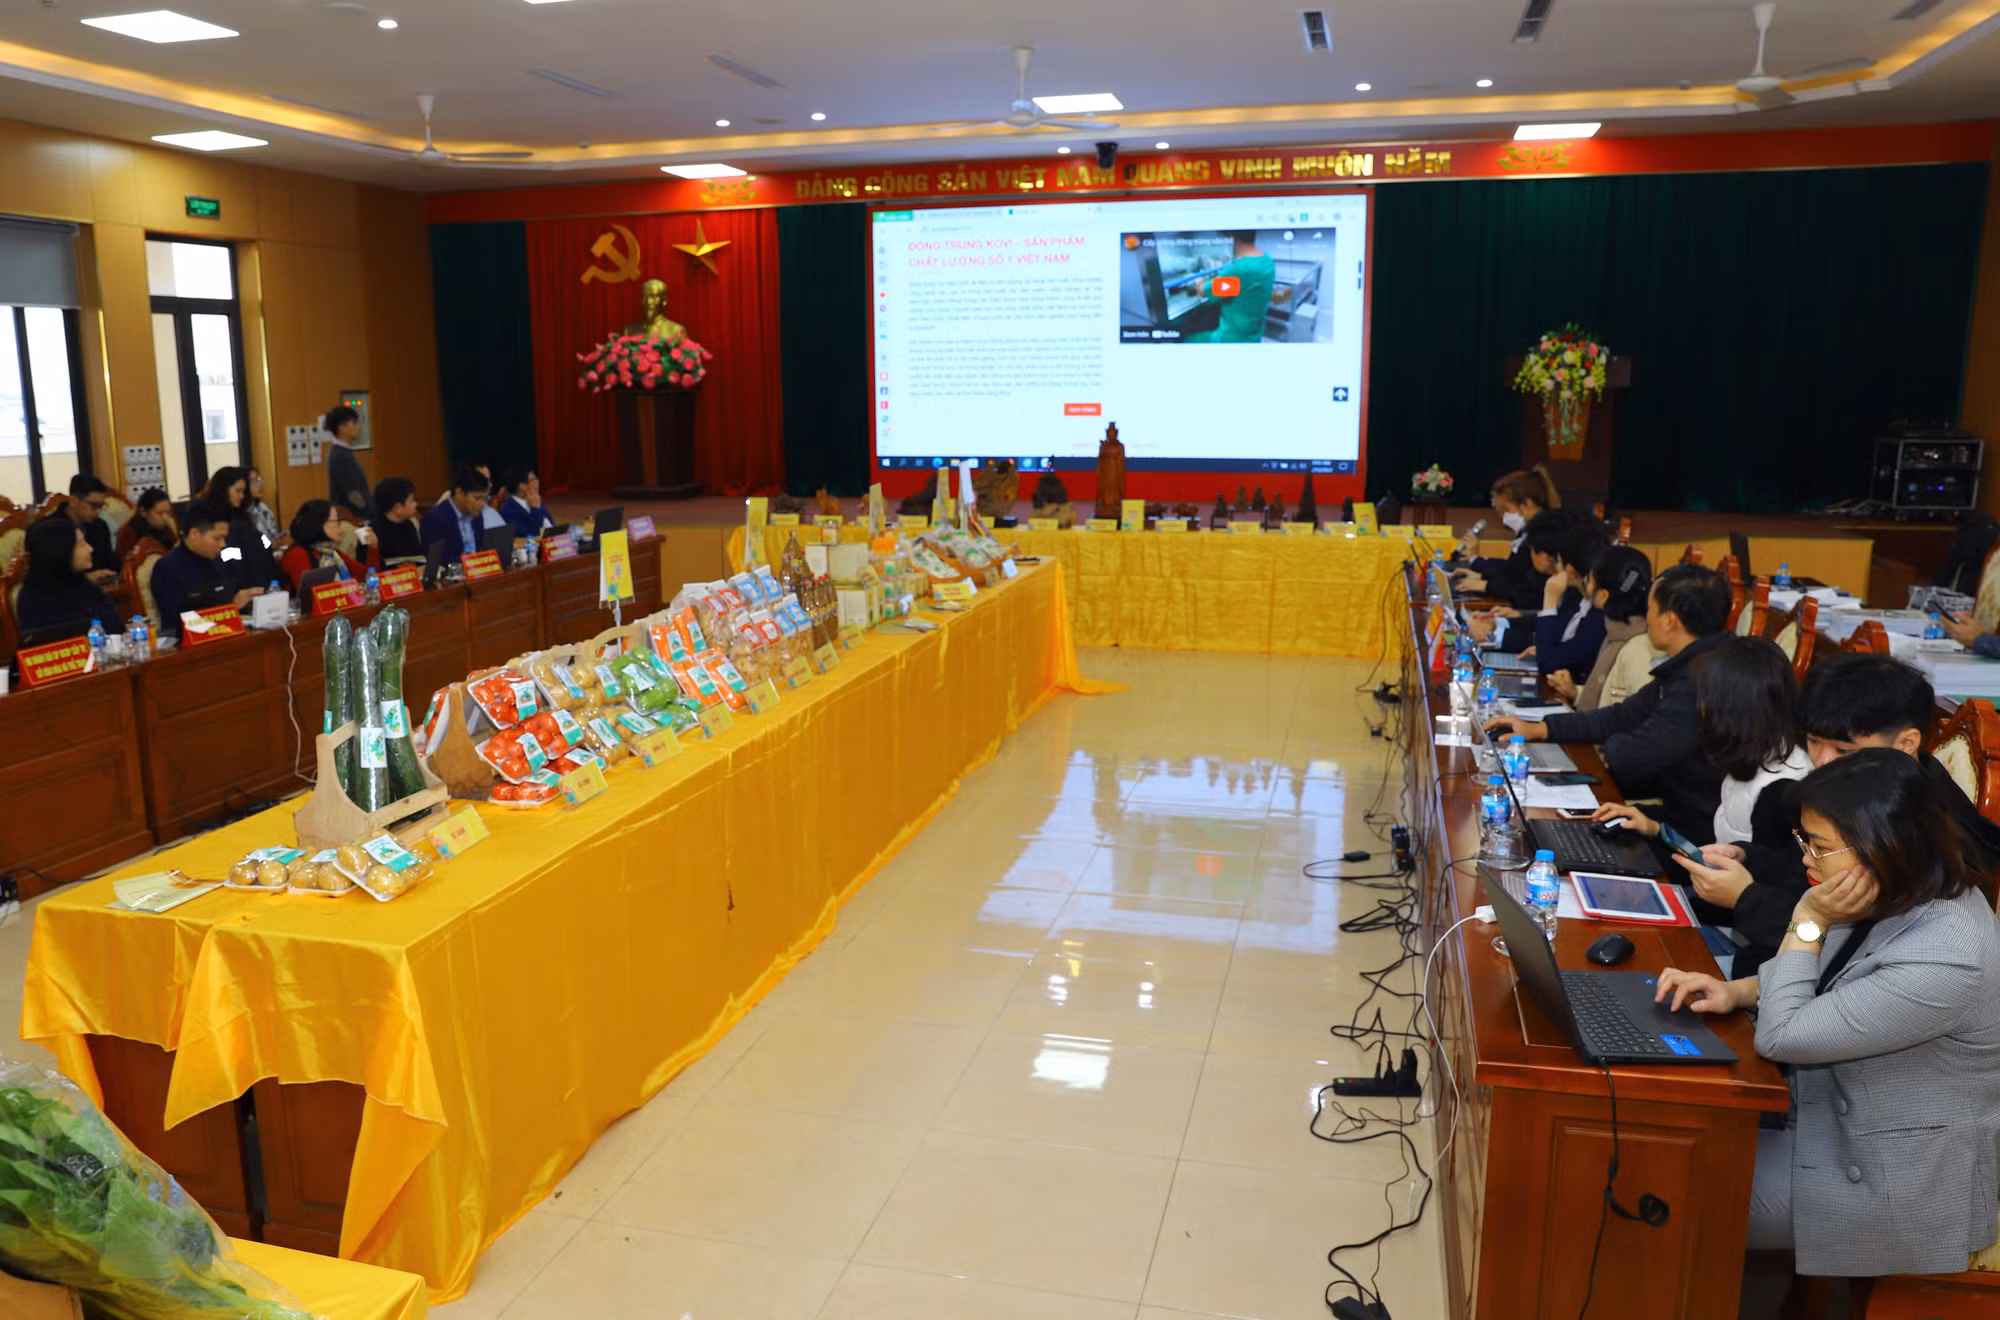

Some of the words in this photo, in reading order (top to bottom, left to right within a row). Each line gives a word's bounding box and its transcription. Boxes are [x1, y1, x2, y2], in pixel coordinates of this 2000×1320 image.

[795, 172, 859, 198] ĐẢNG
[864, 169, 928, 199] CỘNG
[937, 164, 987, 191] SẢN
[996, 164, 1047, 192] VIỆT
[1056, 163, 1116, 187] NAM
[1123, 160, 1210, 185] QUANG
[1220, 157, 1282, 179] VINH
[1292, 151, 1374, 177] MUÔN
[1384, 147, 1451, 174] NĂM
